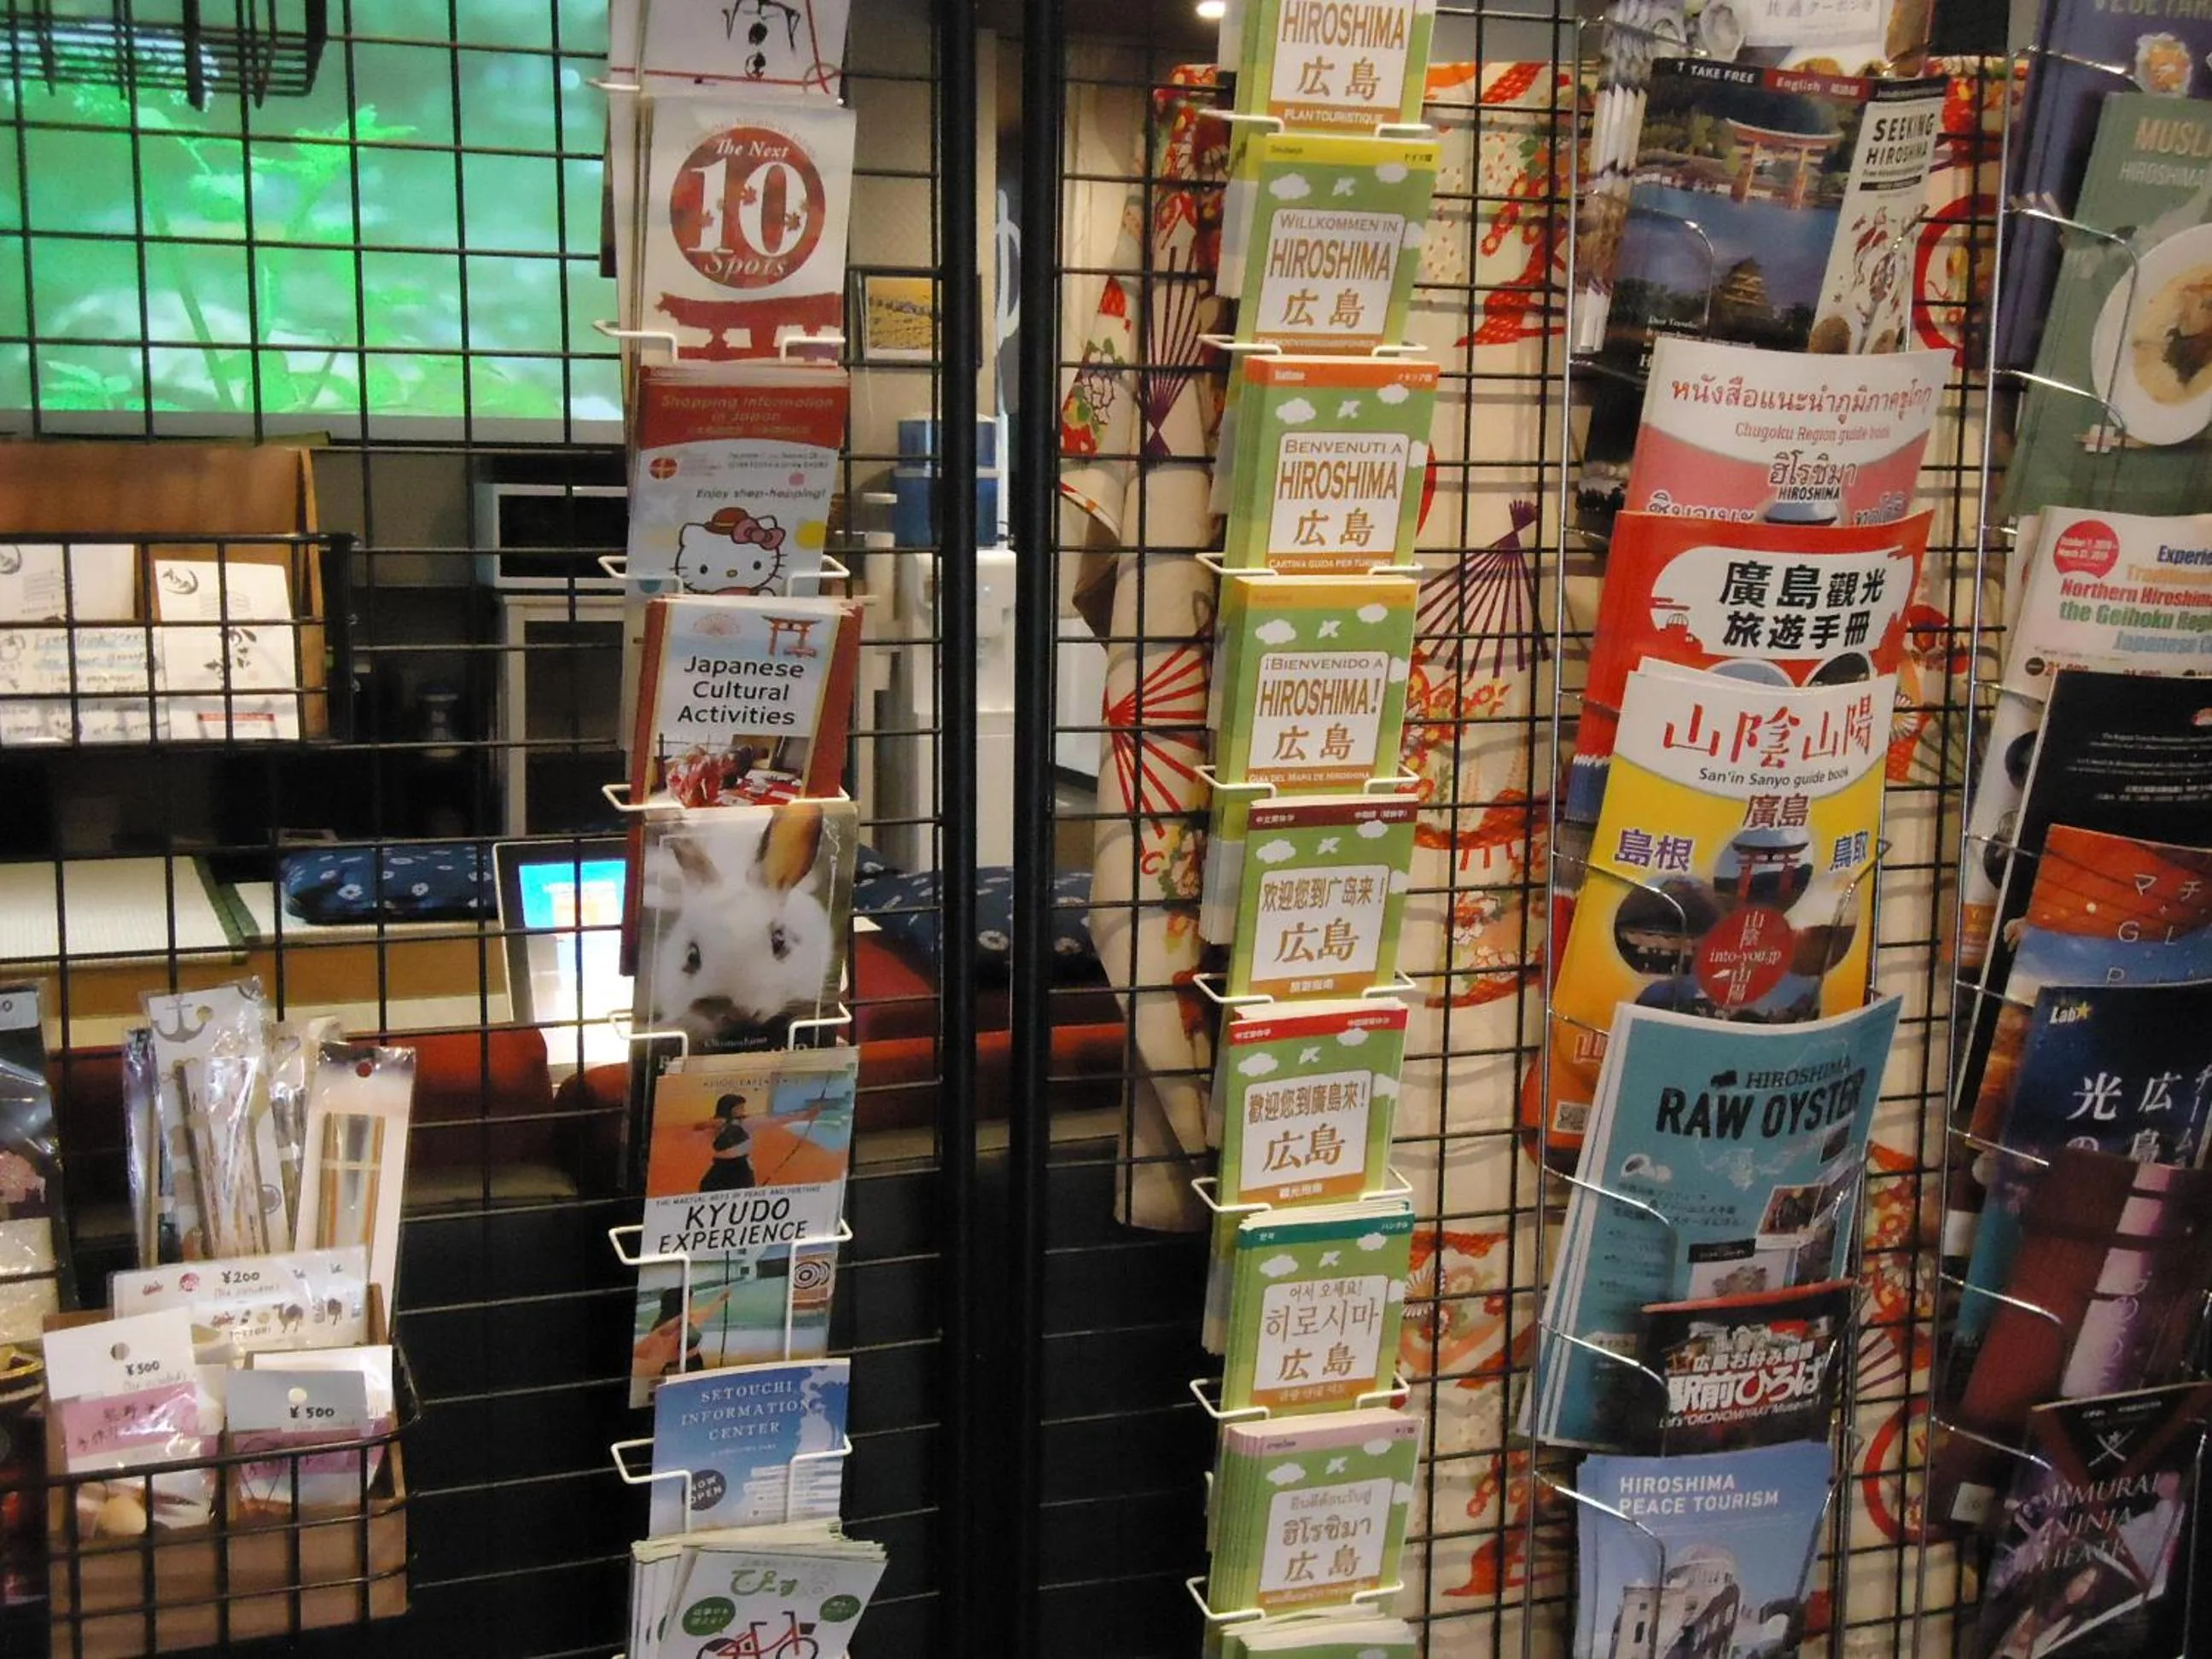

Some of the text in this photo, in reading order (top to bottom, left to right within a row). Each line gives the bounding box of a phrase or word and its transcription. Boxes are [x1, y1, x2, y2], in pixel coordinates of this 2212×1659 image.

[1282, 0, 1405, 49] HIROSHIMA
[1296, 55, 1381, 101] 広島
[1691, 64, 1755, 84] TAKE FREE
[1777, 77, 1821, 93] English
[1873, 114, 1935, 142] SEEKING
[716, 139, 789, 160] The Next
[687, 158, 809, 257] 10
[705, 253, 788, 277] Spots
[1269, 238, 1392, 281] HIROSHIMA
[1281, 288, 1365, 329] 広島
[661, 395, 835, 410] Shopping Information
[1284, 439, 1402, 455] BENVENUTI A
[1736, 422, 1795, 443] Chugoku
[1798, 427, 1837, 443] Region
[696, 487, 729, 501] Enjoy
[1278, 461, 1398, 500] HIROSHIMA
[1778, 487, 1841, 502] HIROSHIMA
[1294, 507, 1375, 547] 広島
[1719, 560, 1887, 610] 廣島觀光
[2060, 578, 2138, 603] Northern
[1722, 609, 1871, 650] 旅遊手冊
[2059, 600, 2092, 623] the
[2096, 603, 2174, 630] Geihoku
[684, 655, 805, 679] Japanese
[1372, 657, 1383, 669] A
[693, 680, 790, 701] Cultural
[1259, 678, 1381, 718] HIROSHIMA!
[678, 704, 796, 725] Activities
[1272, 723, 1355, 761] 広島
[1662, 692, 1875, 770] 山陰山陽
[1749, 769, 1790, 788] Sanyo
[1793, 769, 1826, 788] guide
[1827, 763, 1850, 782] book
[1742, 795, 1811, 829] 廣島
[1614, 829, 1693, 872] 島根
[1274, 917, 1359, 963] 広島
[1746, 1054, 1851, 1089] HIROSHIMA
[1656, 1068, 1866, 1141] RAW OYSTER
[1262, 1123, 1345, 1173] 広島
[685, 1197, 790, 1231] KYUDO
[659, 1220, 807, 1254] EXPERIENCE
[222, 1271, 260, 1284] ¥200
[1266, 1297, 1380, 1344] 히로시마
[125, 1360, 160, 1377] ¥500
[1278, 1342, 1356, 1382] 広島
[701, 1380, 792, 1404] SETOUCHI
[681, 1399, 812, 1428] INFORMATION
[708, 1422, 780, 1443] CENTER
[1621, 1474, 1734, 1495] HIROSHIMA
[1621, 1490, 1778, 1516] PEACE TOURISM
[1284, 1544, 1361, 1582] 広島
